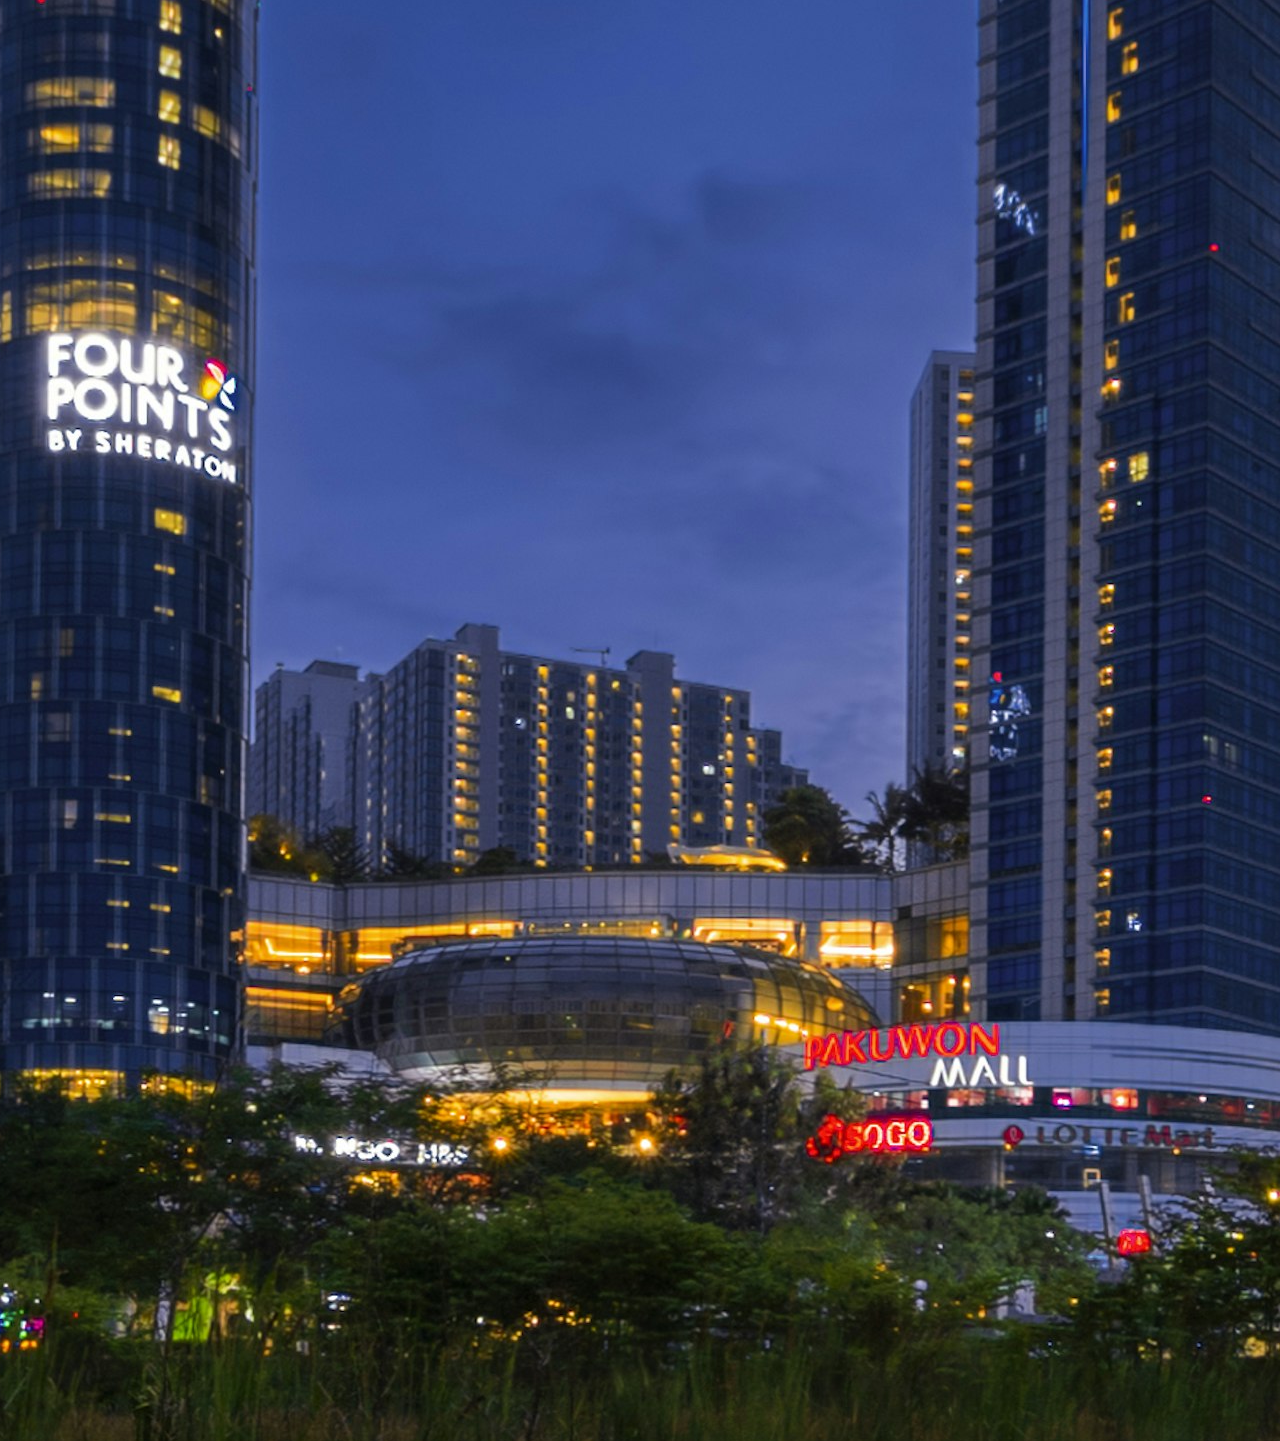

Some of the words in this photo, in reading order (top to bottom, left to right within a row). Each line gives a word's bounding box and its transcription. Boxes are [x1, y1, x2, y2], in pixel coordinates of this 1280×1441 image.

[47, 333, 189, 393] FOUR
[47, 377, 232, 451] POINTS
[48, 429, 82, 451] BY
[95, 430, 236, 483] SHERATON
[804, 1022, 1000, 1071] PAKUWON
[929, 1054, 1035, 1087] MALL
[844, 1121, 932, 1151] SOGO
